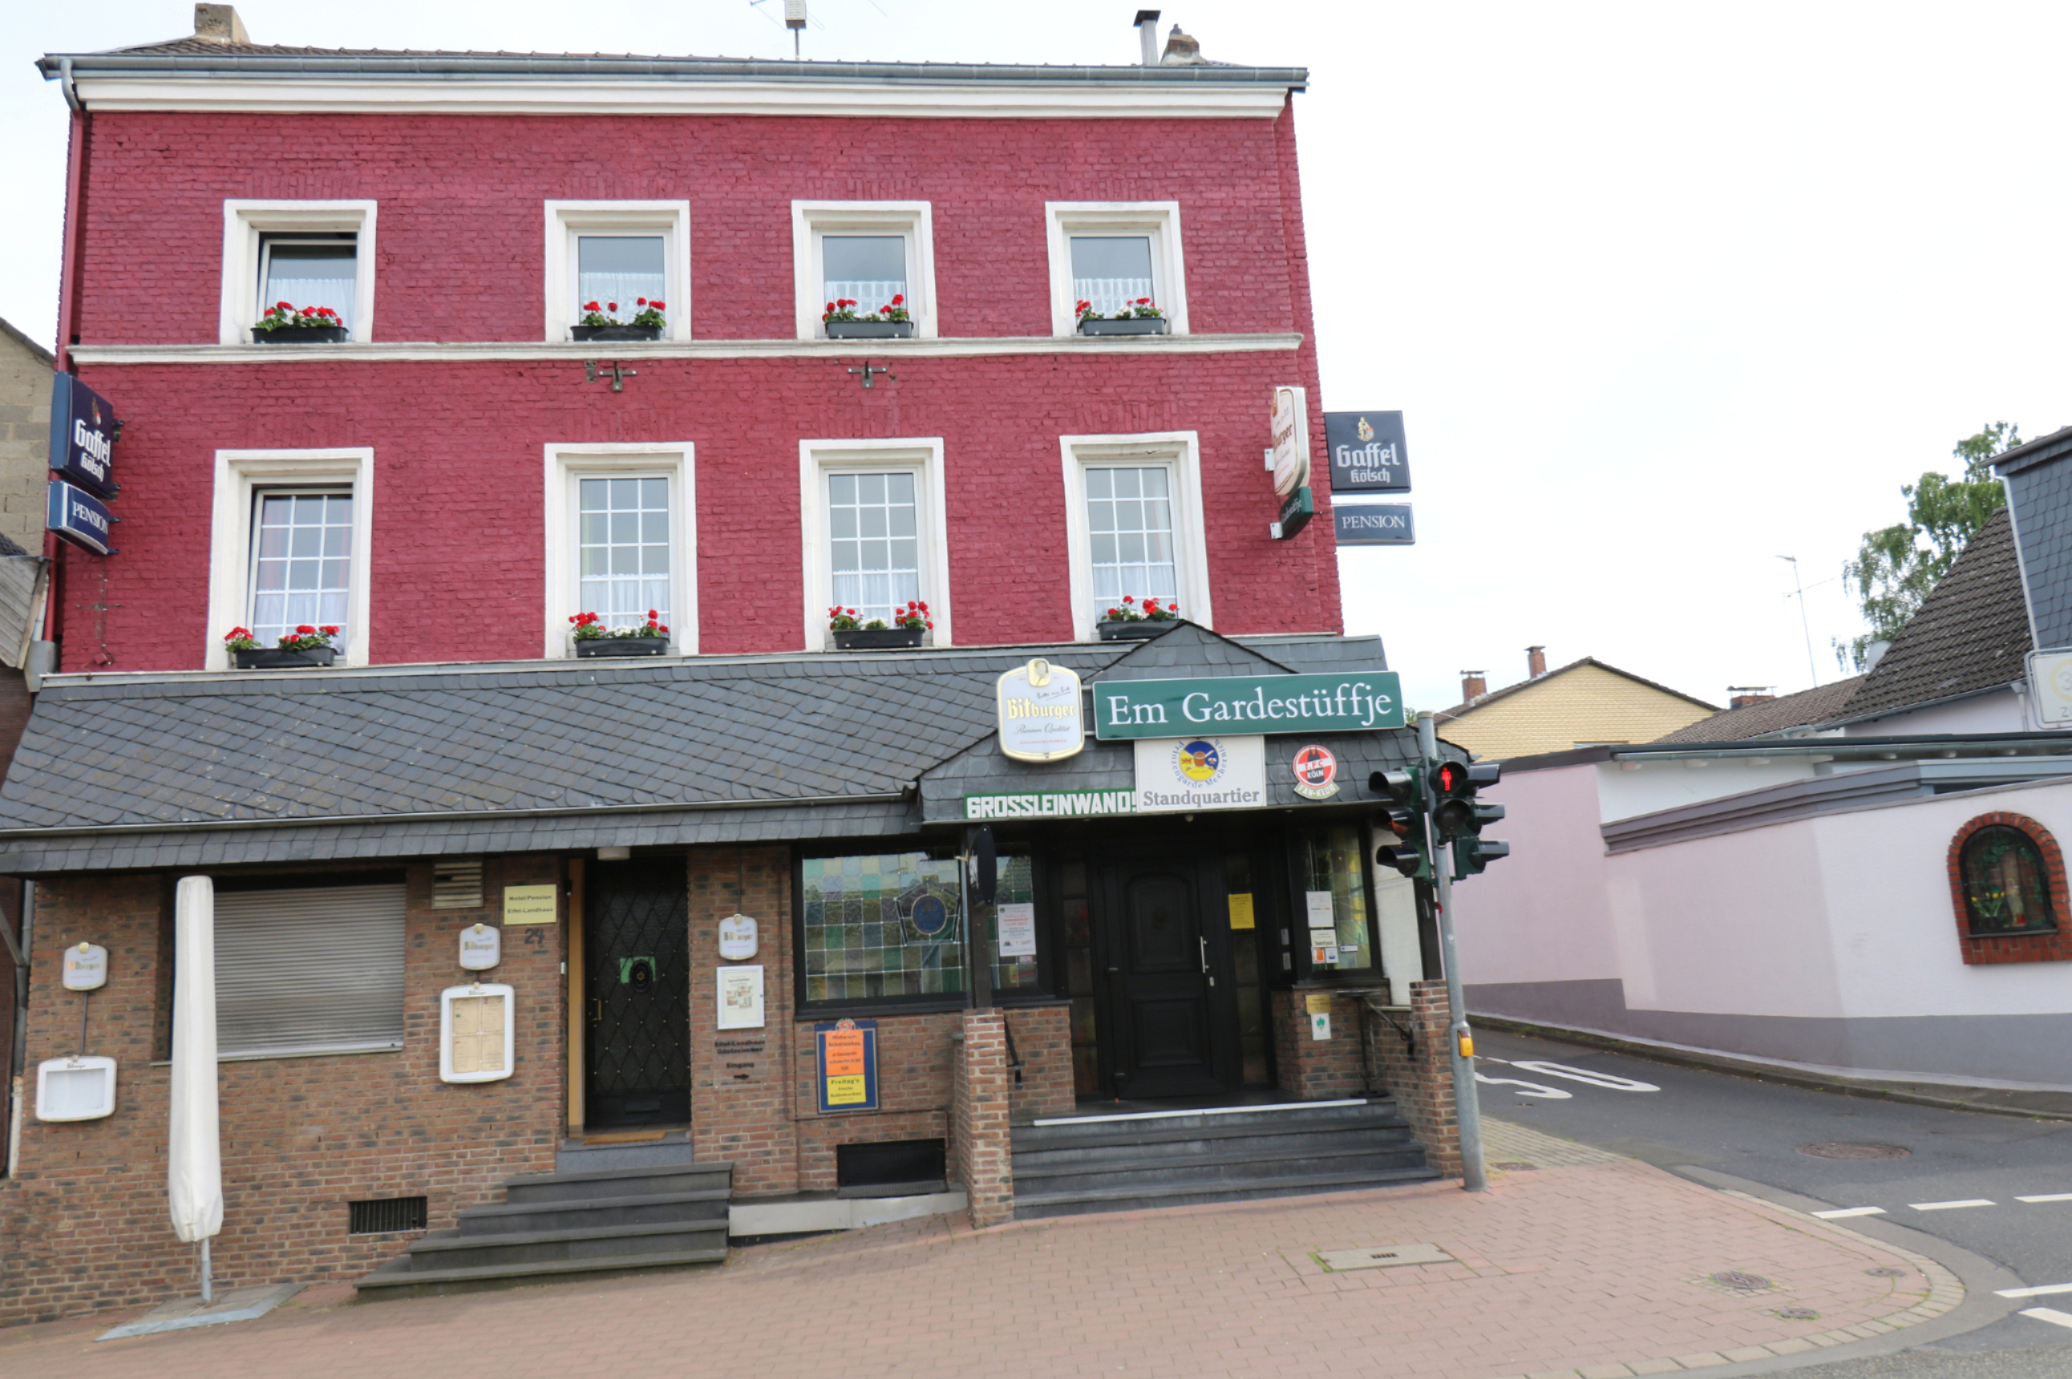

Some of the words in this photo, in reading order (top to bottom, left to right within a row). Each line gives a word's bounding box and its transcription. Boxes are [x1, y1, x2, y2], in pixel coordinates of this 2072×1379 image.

[75, 418, 111, 468] Gaffel
[1335, 442, 1401, 468] Gaffel
[80, 451, 105, 483] Kölsch
[1350, 468, 1391, 484] Kölsch
[72, 500, 109, 536] PENSION
[1341, 515, 1405, 529] PENSION
[1007, 697, 1076, 720] Bitburger
[1107, 695, 1168, 725] Em
[1182, 682, 1392, 727] Gardestüffje
[1171, 740, 1203, 789] Prinzengarde
[1205, 739, 1228, 788] Mechernich
[1307, 768, 1324, 779] KÖLN
[1143, 787, 1260, 808] Standquartier
[1298, 783, 1336, 797] FAN-KLUB
[524, 927, 546, 945] 24
